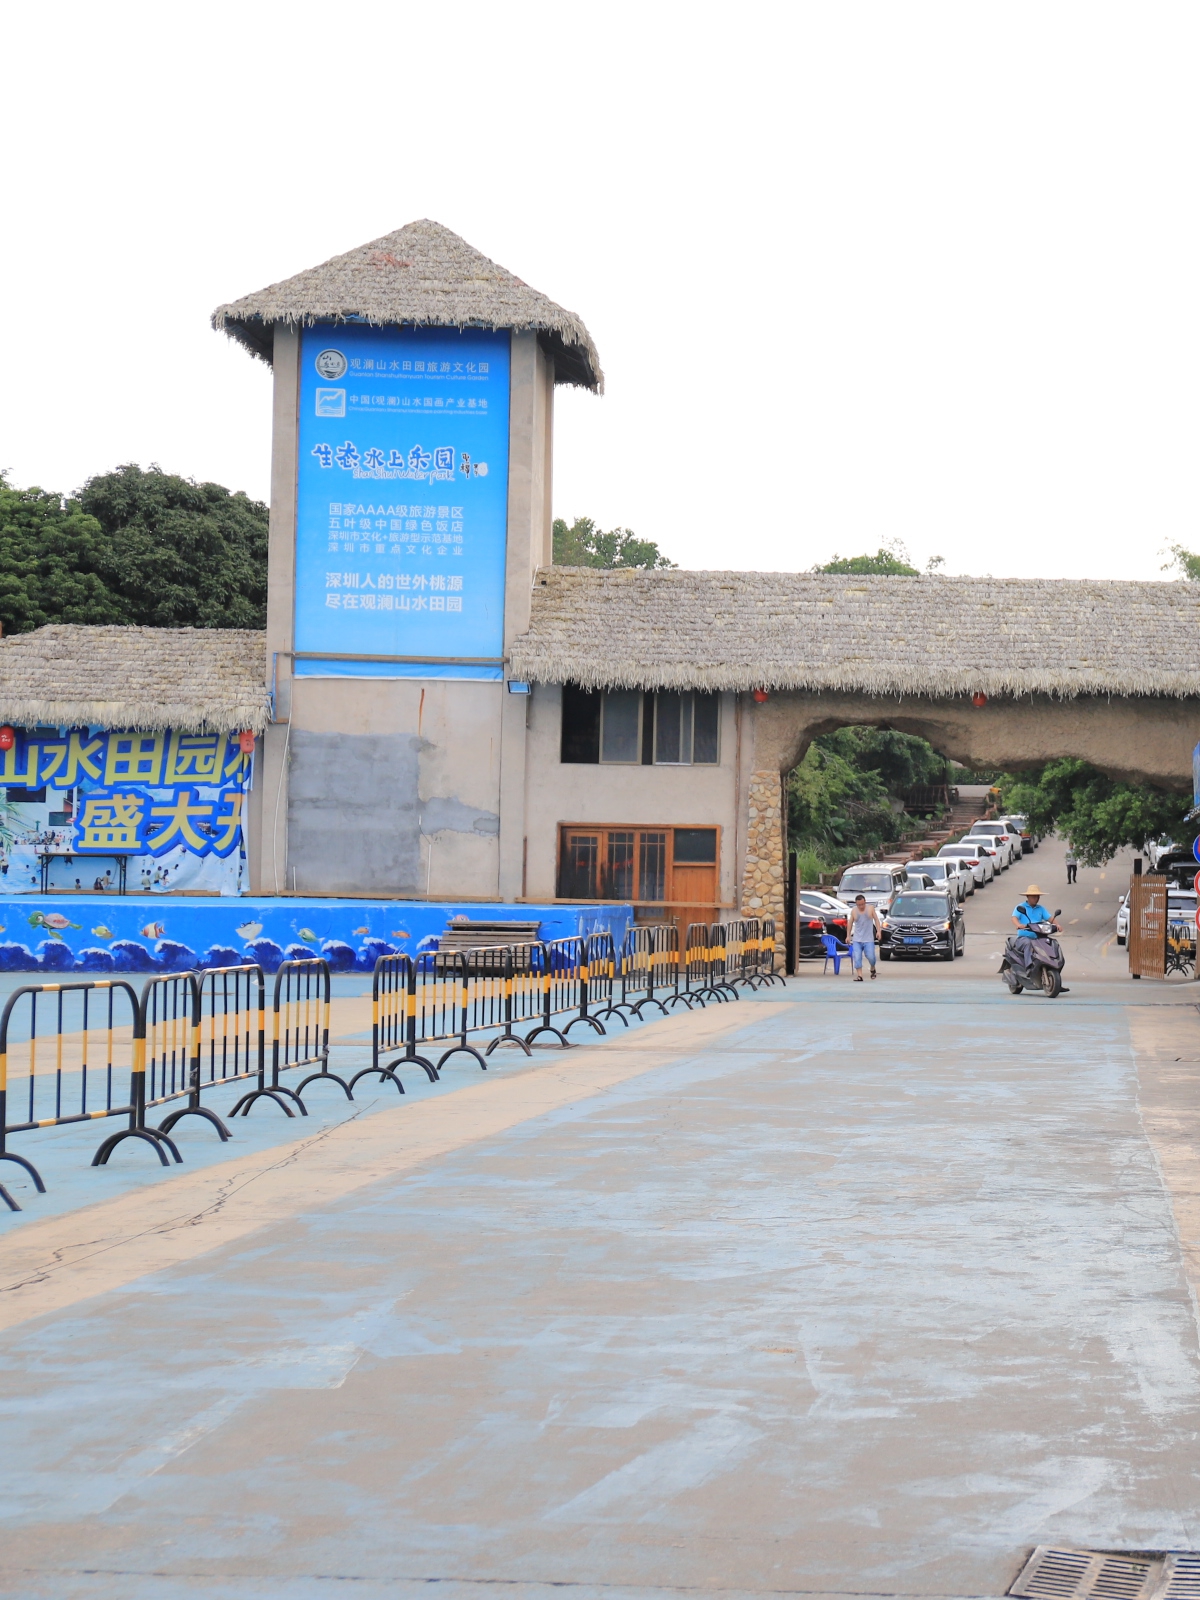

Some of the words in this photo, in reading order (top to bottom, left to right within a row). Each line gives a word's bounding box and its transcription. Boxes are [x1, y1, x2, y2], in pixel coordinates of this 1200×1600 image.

[350, 358, 490, 374] 观澜山水田园旅游文化园
[467, 374, 489, 382] Garden
[312, 441, 455, 471] 生态水上乐园
[329, 502, 464, 519] 国家AAAA级旅游景区
[328, 517, 464, 532] 五叶级中国绿色饭店
[328, 530, 464, 544] 深圳市文化+旅游型示范基地
[327, 542, 463, 556] 深圳市重点文化企业
[325, 572, 463, 591] 深圳人的世外桃源
[325, 593, 463, 612] 尽在观澜山水田园
